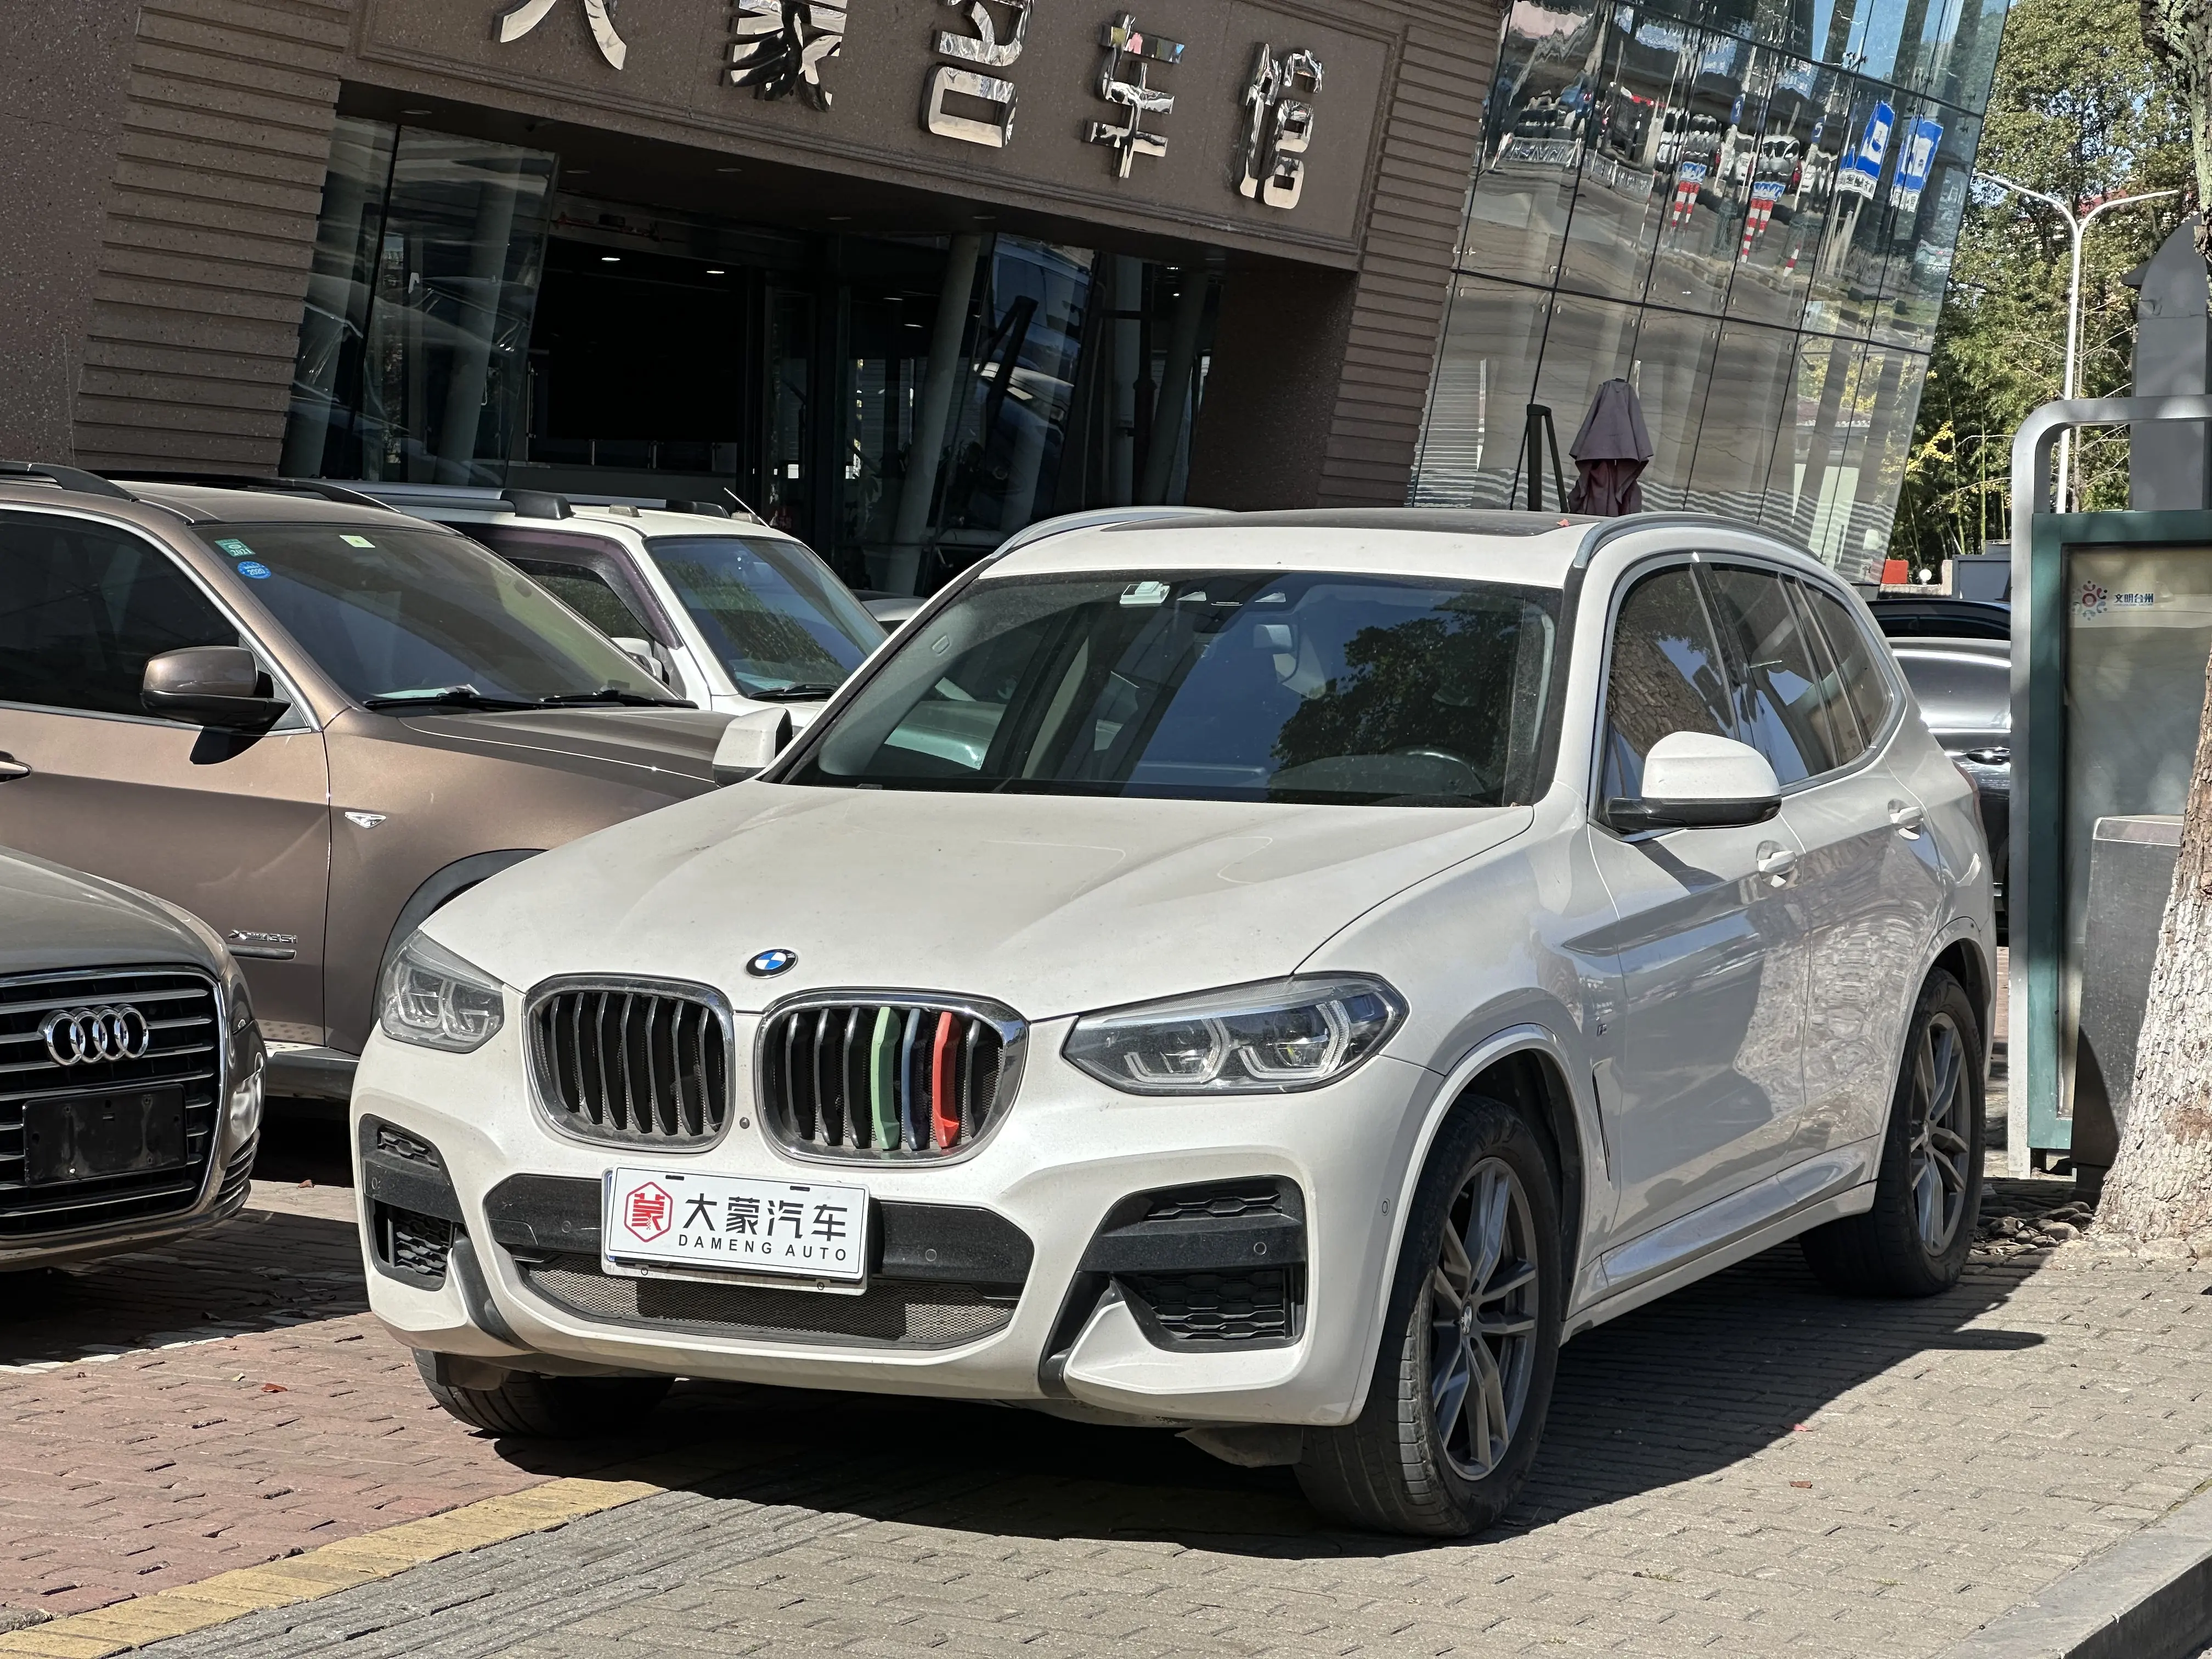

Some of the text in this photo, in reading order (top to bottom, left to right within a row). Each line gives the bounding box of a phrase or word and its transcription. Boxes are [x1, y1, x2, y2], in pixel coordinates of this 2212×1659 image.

[2114, 594, 2154, 603] 文明台州
[682, 1193, 848, 1242] 大蒙汽车
[679, 1234, 847, 1261] DAMENG AUTO
